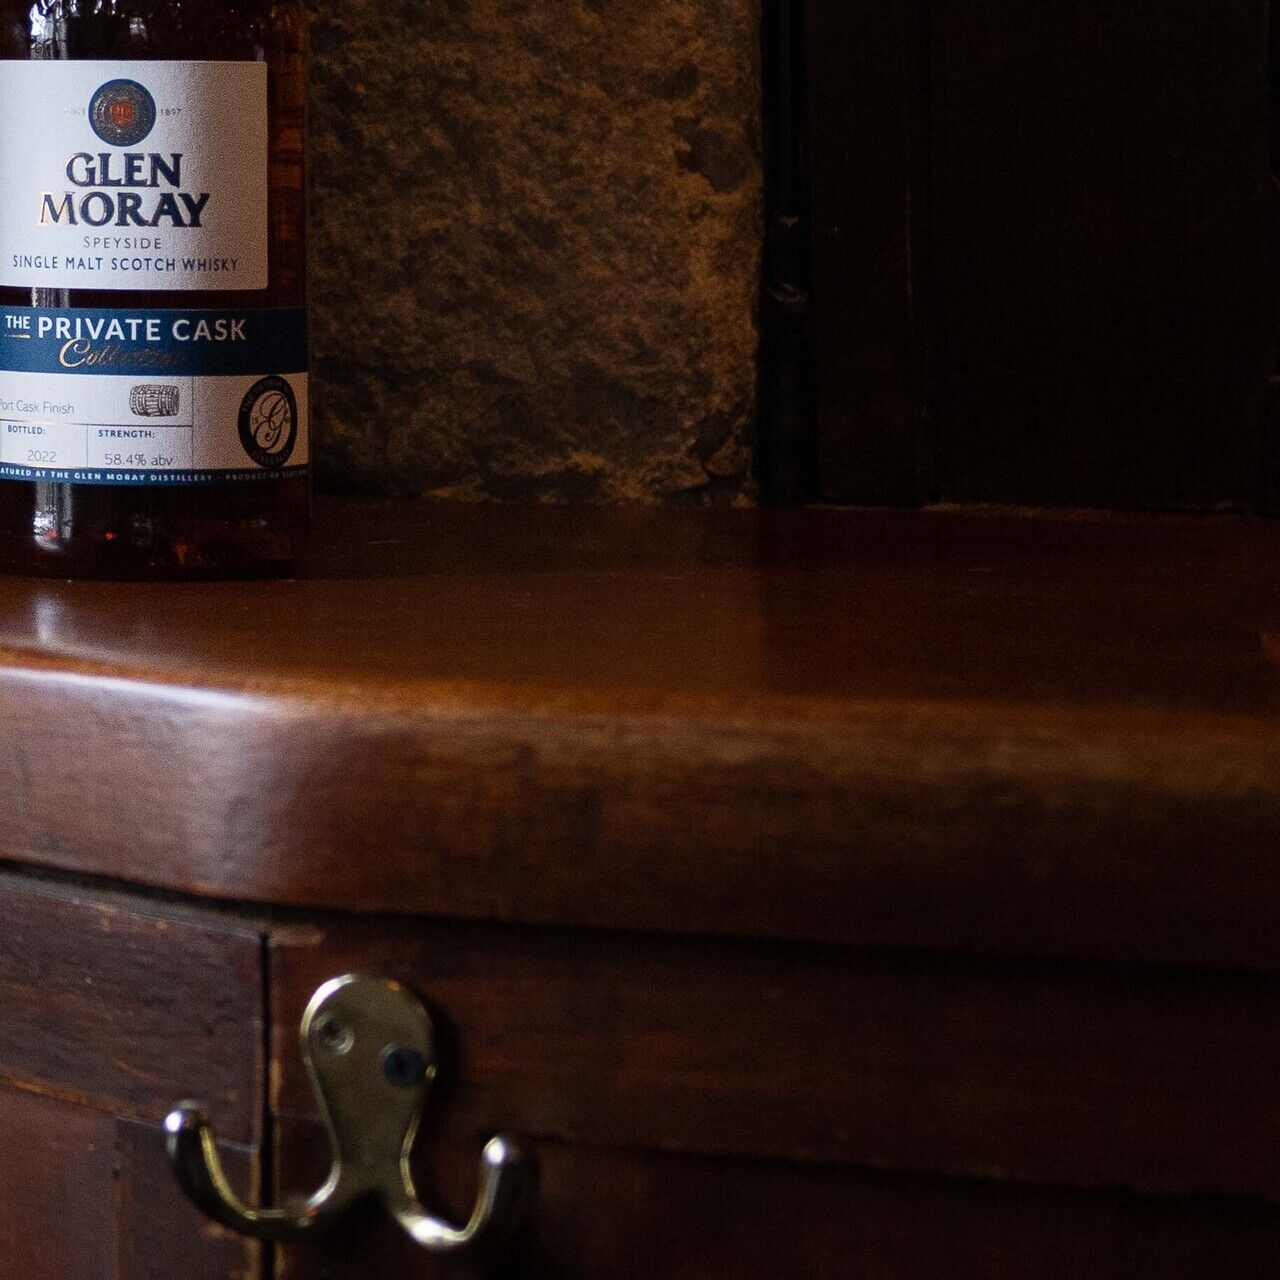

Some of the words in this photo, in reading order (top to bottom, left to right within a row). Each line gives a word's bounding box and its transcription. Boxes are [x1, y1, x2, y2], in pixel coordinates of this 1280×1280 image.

[66, 152, 183, 189] GLEN
[40, 190, 210, 228] MORAY
[83, 235, 162, 250] SPEYSIDE
[13, 254, 59, 269] SINGLE
[65, 256, 103, 271] MALT
[111, 257, 176, 272] SCOTCH
[182, 258, 240, 272] WHISKY
[6, 314, 31, 330] THE
[38, 316, 161, 341] PRIVATE
[172, 318, 248, 342] CASK
[16, 400, 40, 412] Cask
[43, 401, 75, 414] Finish
[7, 425, 46, 436] BOTTLED:
[98, 429, 156, 440] STRENGTH:
[27, 449, 57, 463] 2022
[105, 453, 147, 467] 58.4%
[151, 454, 174, 467] abv
[35, 469, 46, 478] AT
[51, 471, 69, 479] THE
[74, 472, 101, 480] GLEN
[106, 473, 146, 481] MORAY
[150, 473, 212, 482] DISTILLERY
